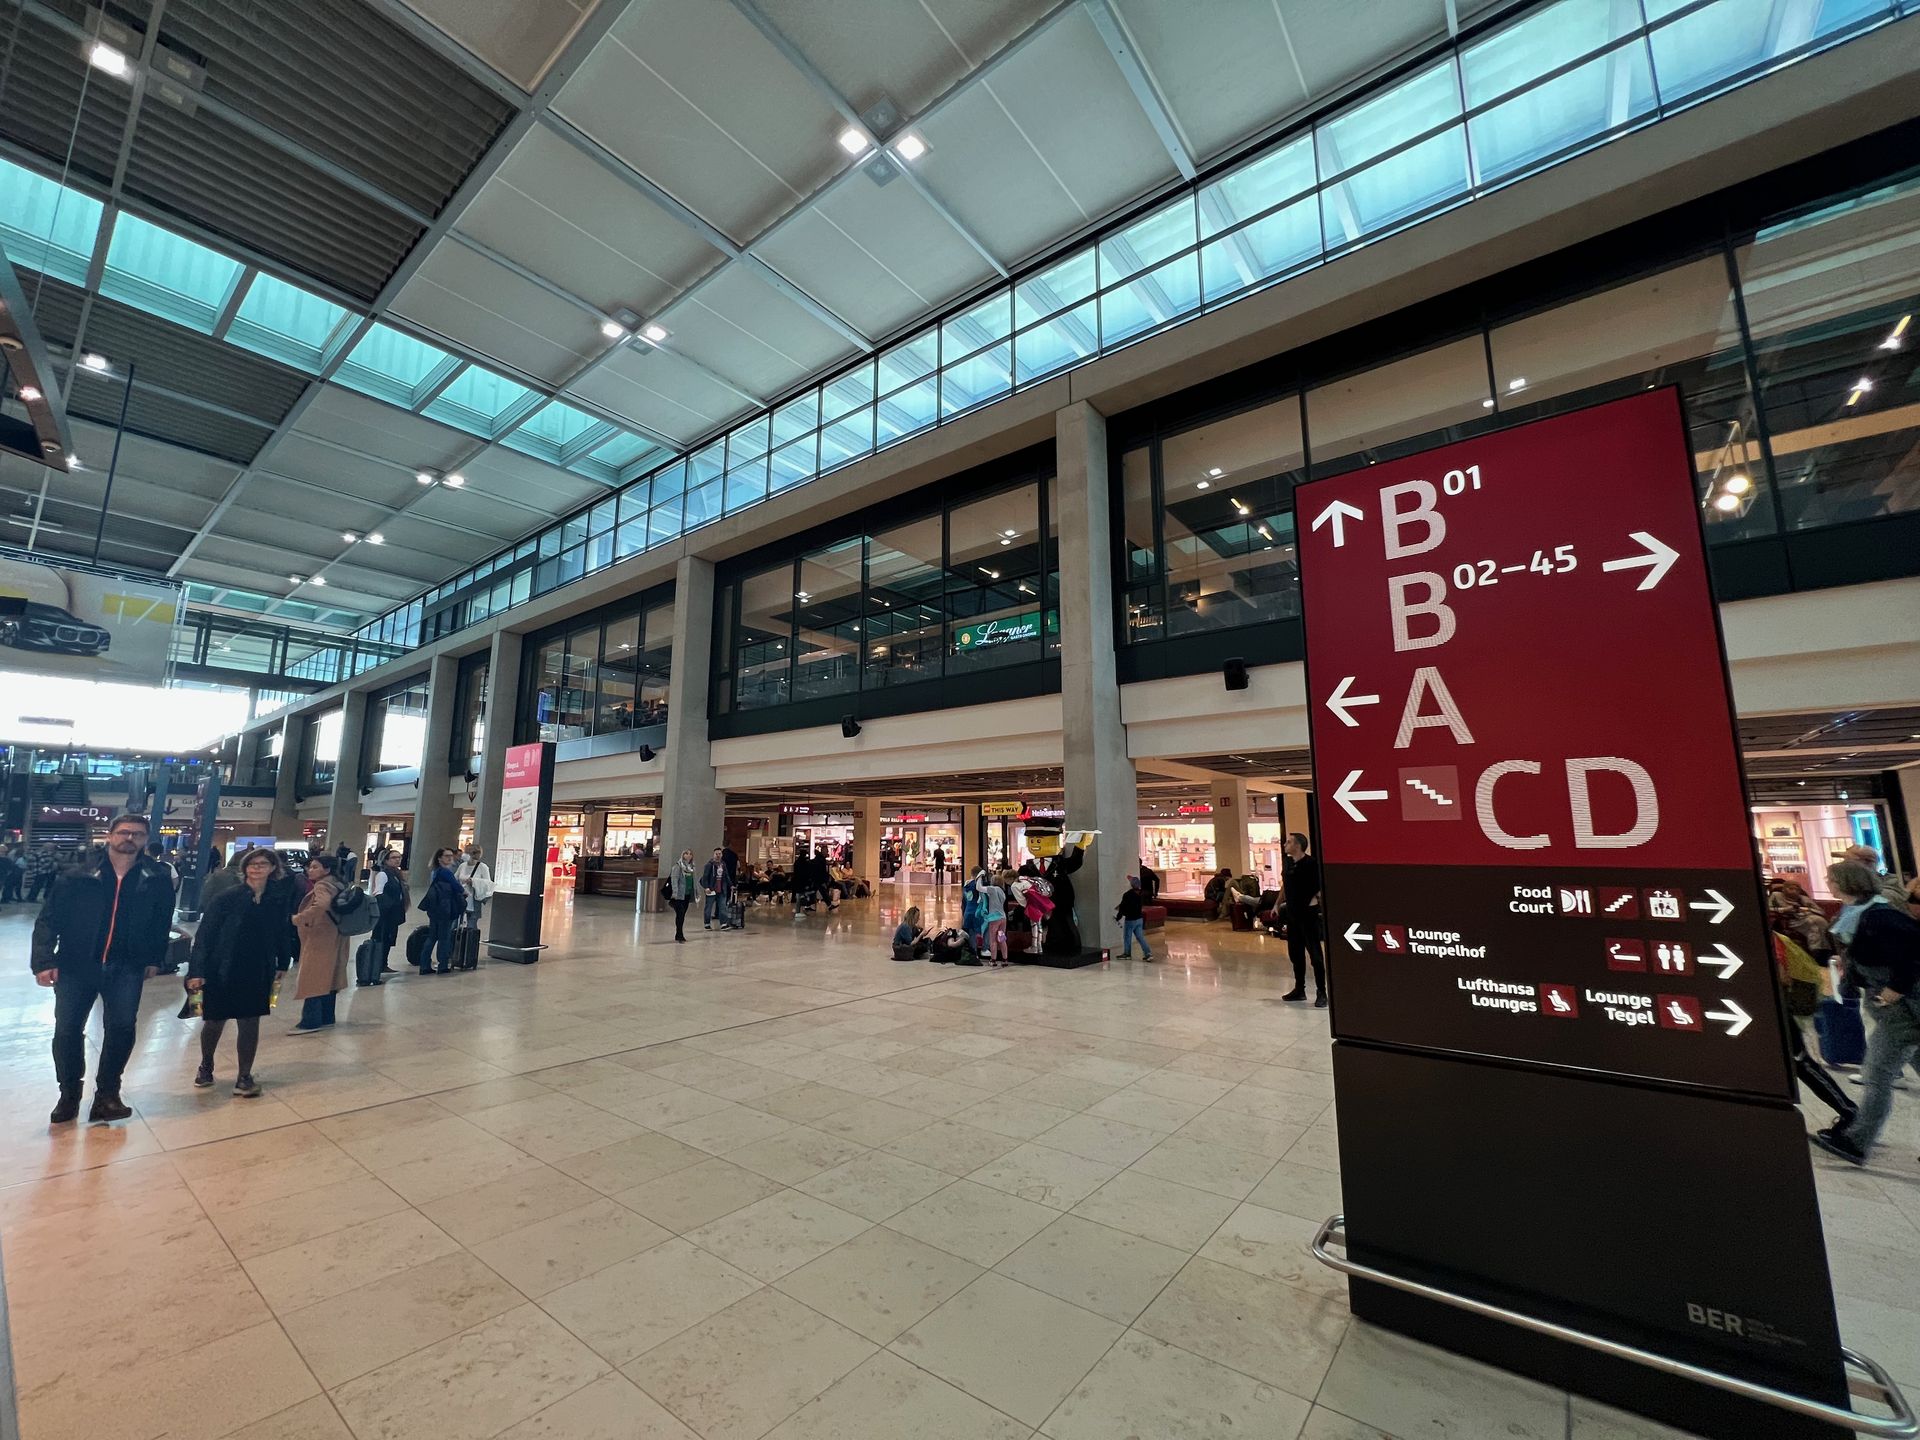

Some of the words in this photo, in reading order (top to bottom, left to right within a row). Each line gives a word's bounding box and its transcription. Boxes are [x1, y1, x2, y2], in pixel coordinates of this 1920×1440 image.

[1393, 666, 1475, 748] A
[1513, 886, 1552, 900] Food
[1509, 900, 1554, 915] Court
[1408, 927, 1461, 944] Lounge
[1409, 942, 1486, 960] Tempelhof
[1457, 977, 1535, 997] Lufthansa
[1471, 993, 1538, 1013] Lounges
[1585, 988, 1652, 1009] Lounge
[1604, 1006, 1656, 1026] Tegel
[1687, 1302, 1744, 1337] BER
